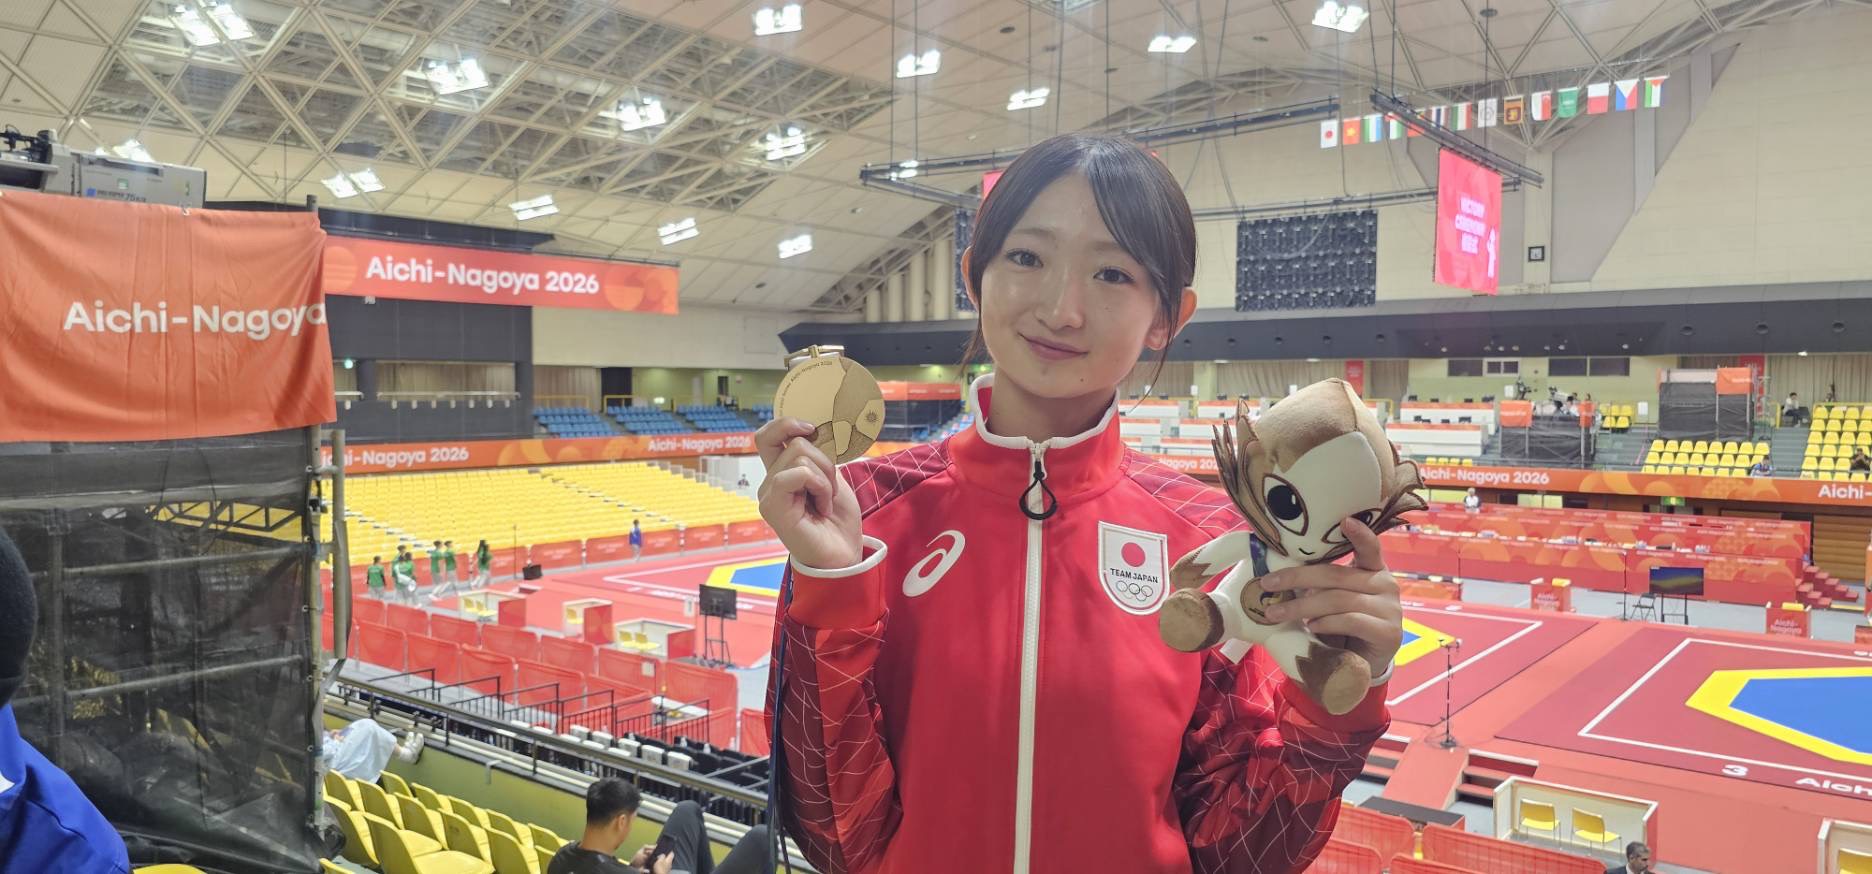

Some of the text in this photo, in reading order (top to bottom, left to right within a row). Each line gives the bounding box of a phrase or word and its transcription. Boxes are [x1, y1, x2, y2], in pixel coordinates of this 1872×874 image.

[366, 256, 600, 295] Aichi-Nagoya 2026
[63, 299, 327, 341] Aichi-Nagoya
[648, 438, 723, 453] Aichi-Nagoya
[430, 447, 470, 462] 2026
[1420, 467, 1549, 484] Aichi-Nagoya 2026
[1818, 483, 1872, 499] Aichi-
[1110, 568, 1158, 583] TEAM JAPAN
[1722, 764, 1748, 776] 3
